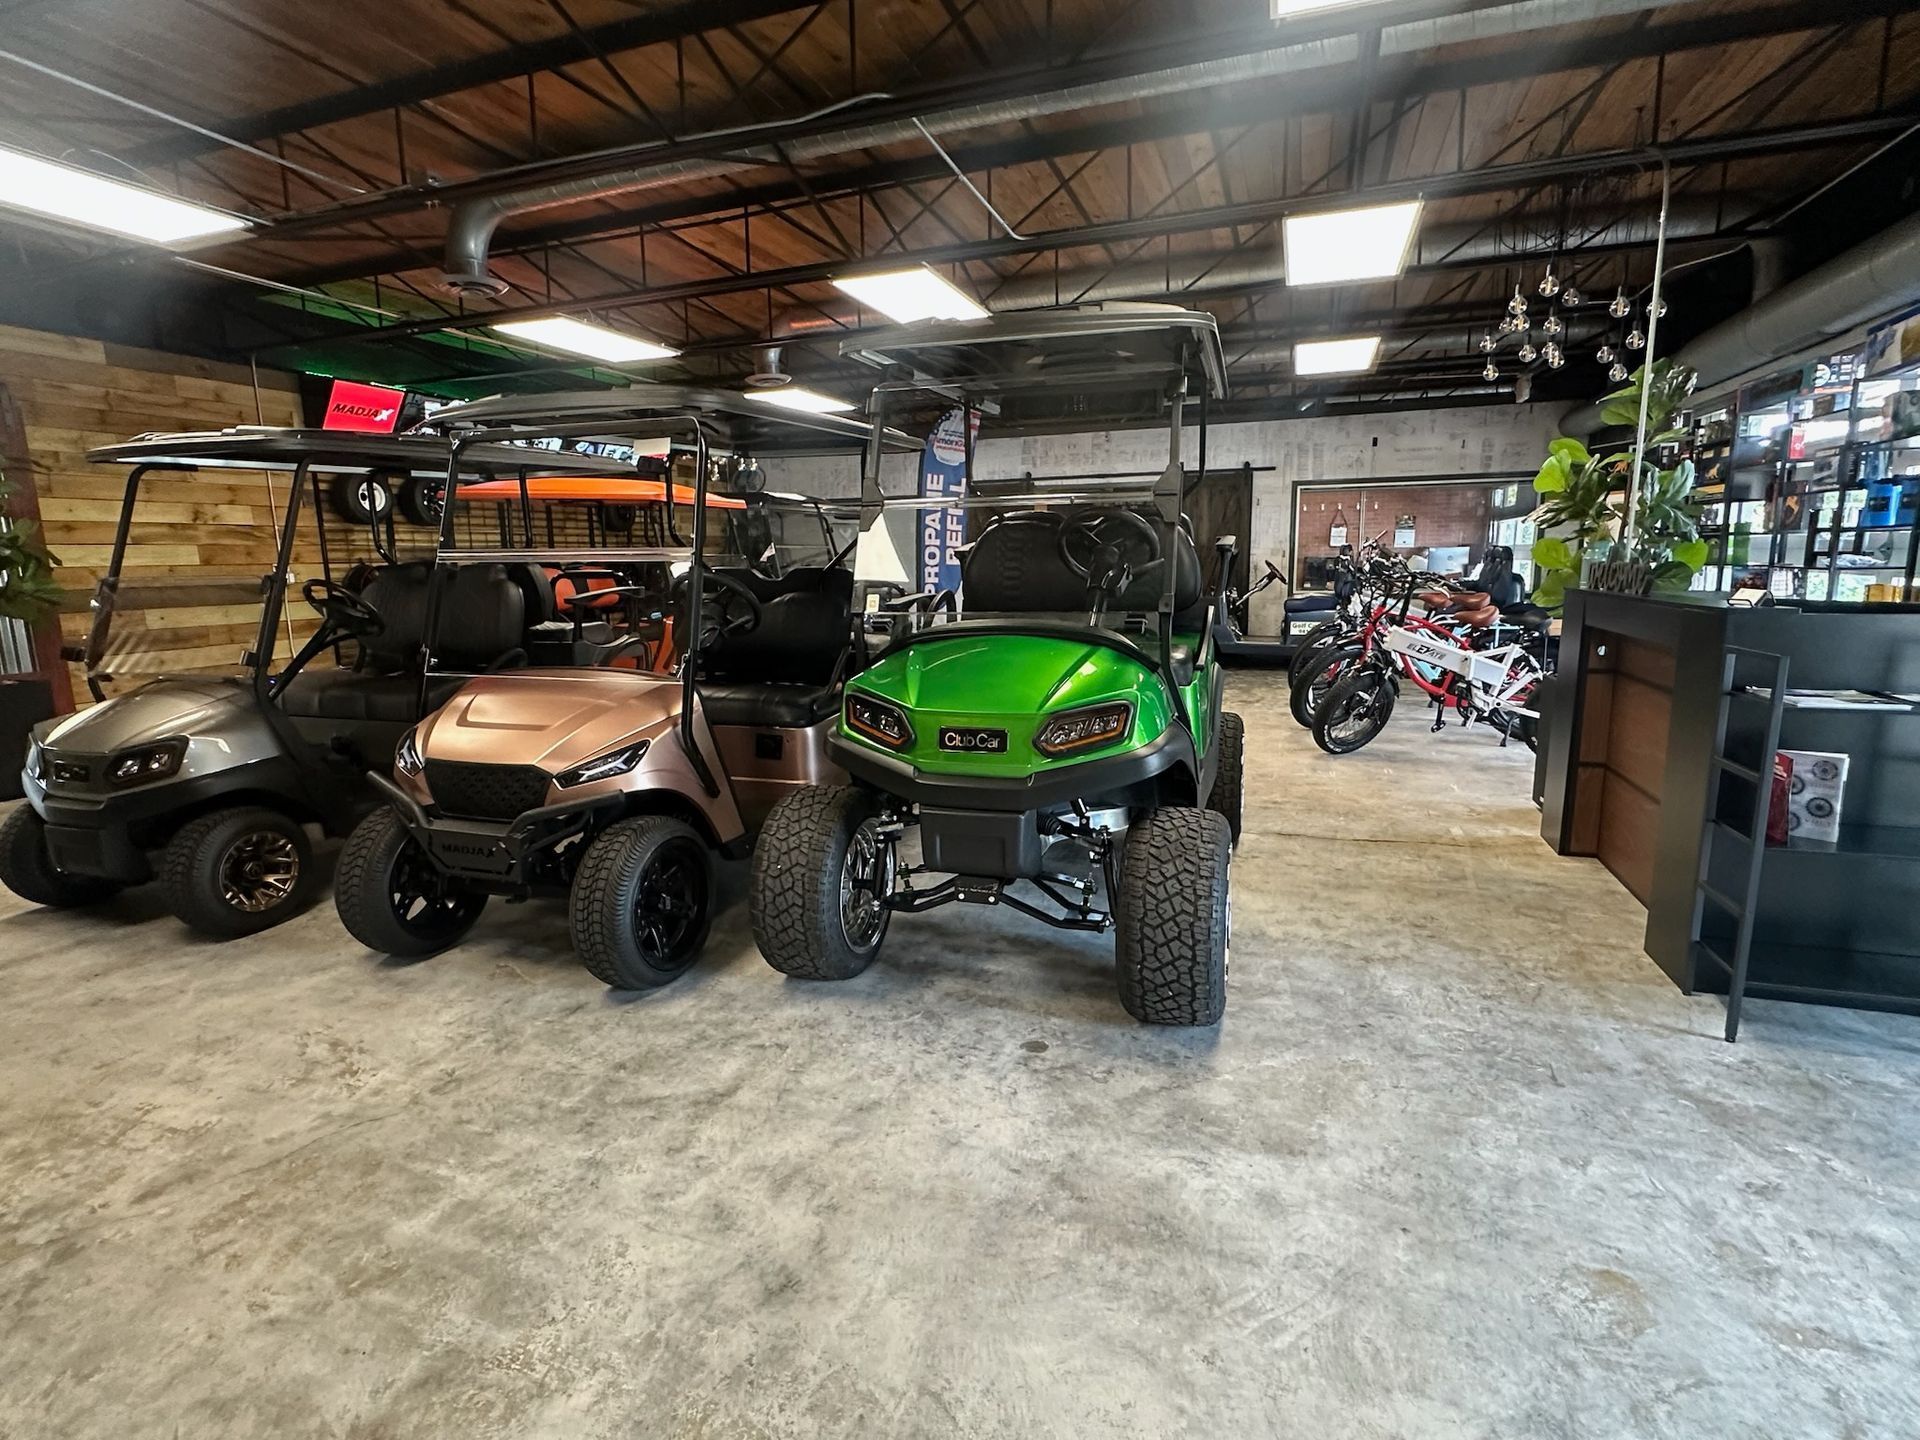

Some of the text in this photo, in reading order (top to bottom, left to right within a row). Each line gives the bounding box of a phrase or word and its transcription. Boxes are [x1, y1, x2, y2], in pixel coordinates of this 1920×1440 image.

[332, 403, 395, 422] MADJAX
[945, 477, 967, 566] REFIL
[1406, 643, 1447, 661] ELEVATE
[944, 731, 1001, 748] Club Car
[441, 844, 497, 858] MADJAX
